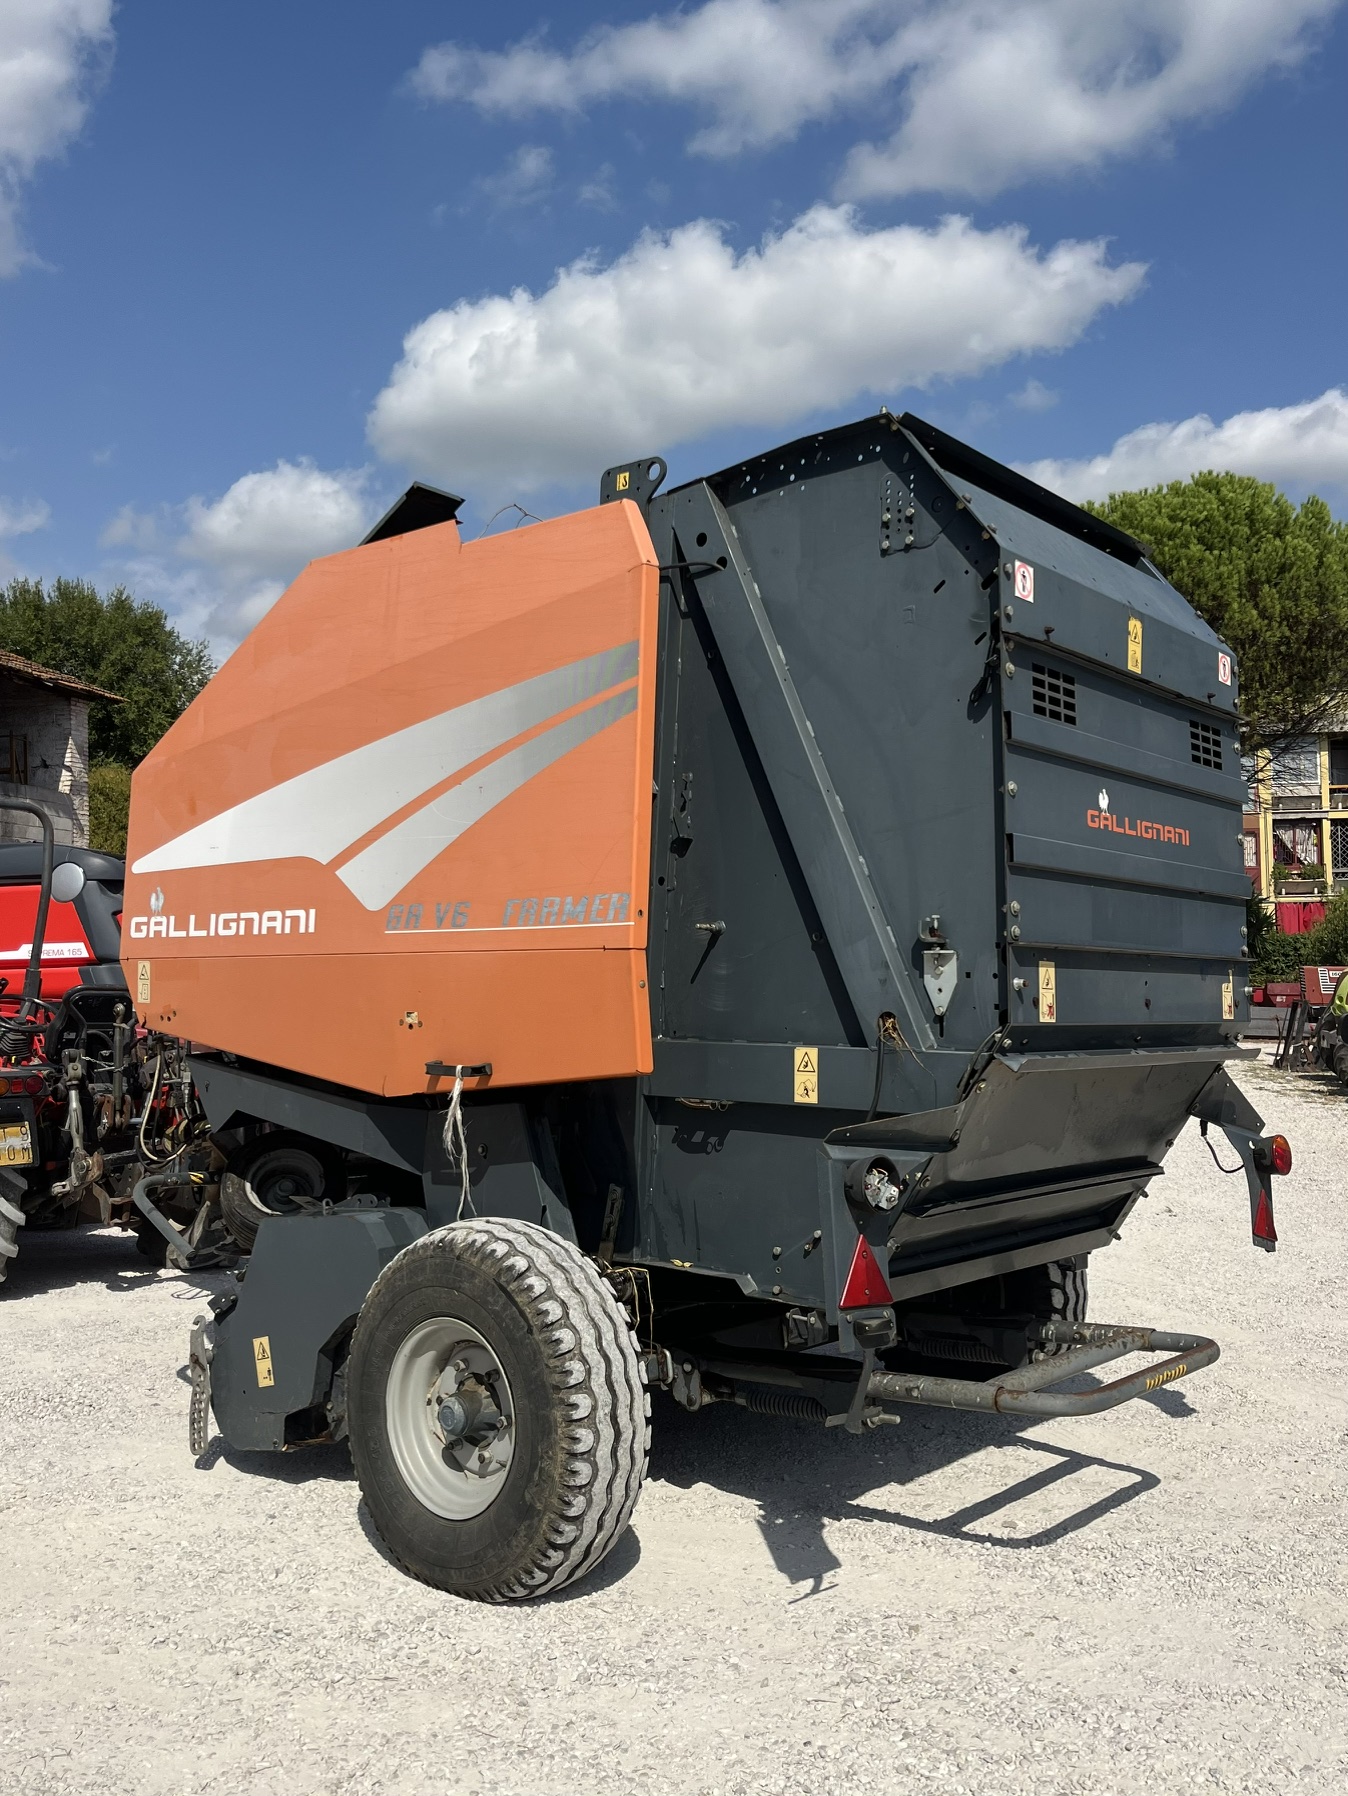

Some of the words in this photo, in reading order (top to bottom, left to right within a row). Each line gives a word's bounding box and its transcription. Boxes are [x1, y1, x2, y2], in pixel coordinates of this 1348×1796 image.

[1087, 809, 1190, 846] GALLIGNANI
[130, 908, 316, 939] GALLIGNANI
[435, 901, 472, 928] V6
[502, 892, 631, 926] FARMER
[27, 949, 65, 958] SREMA
[67, 947, 83, 956] 165
